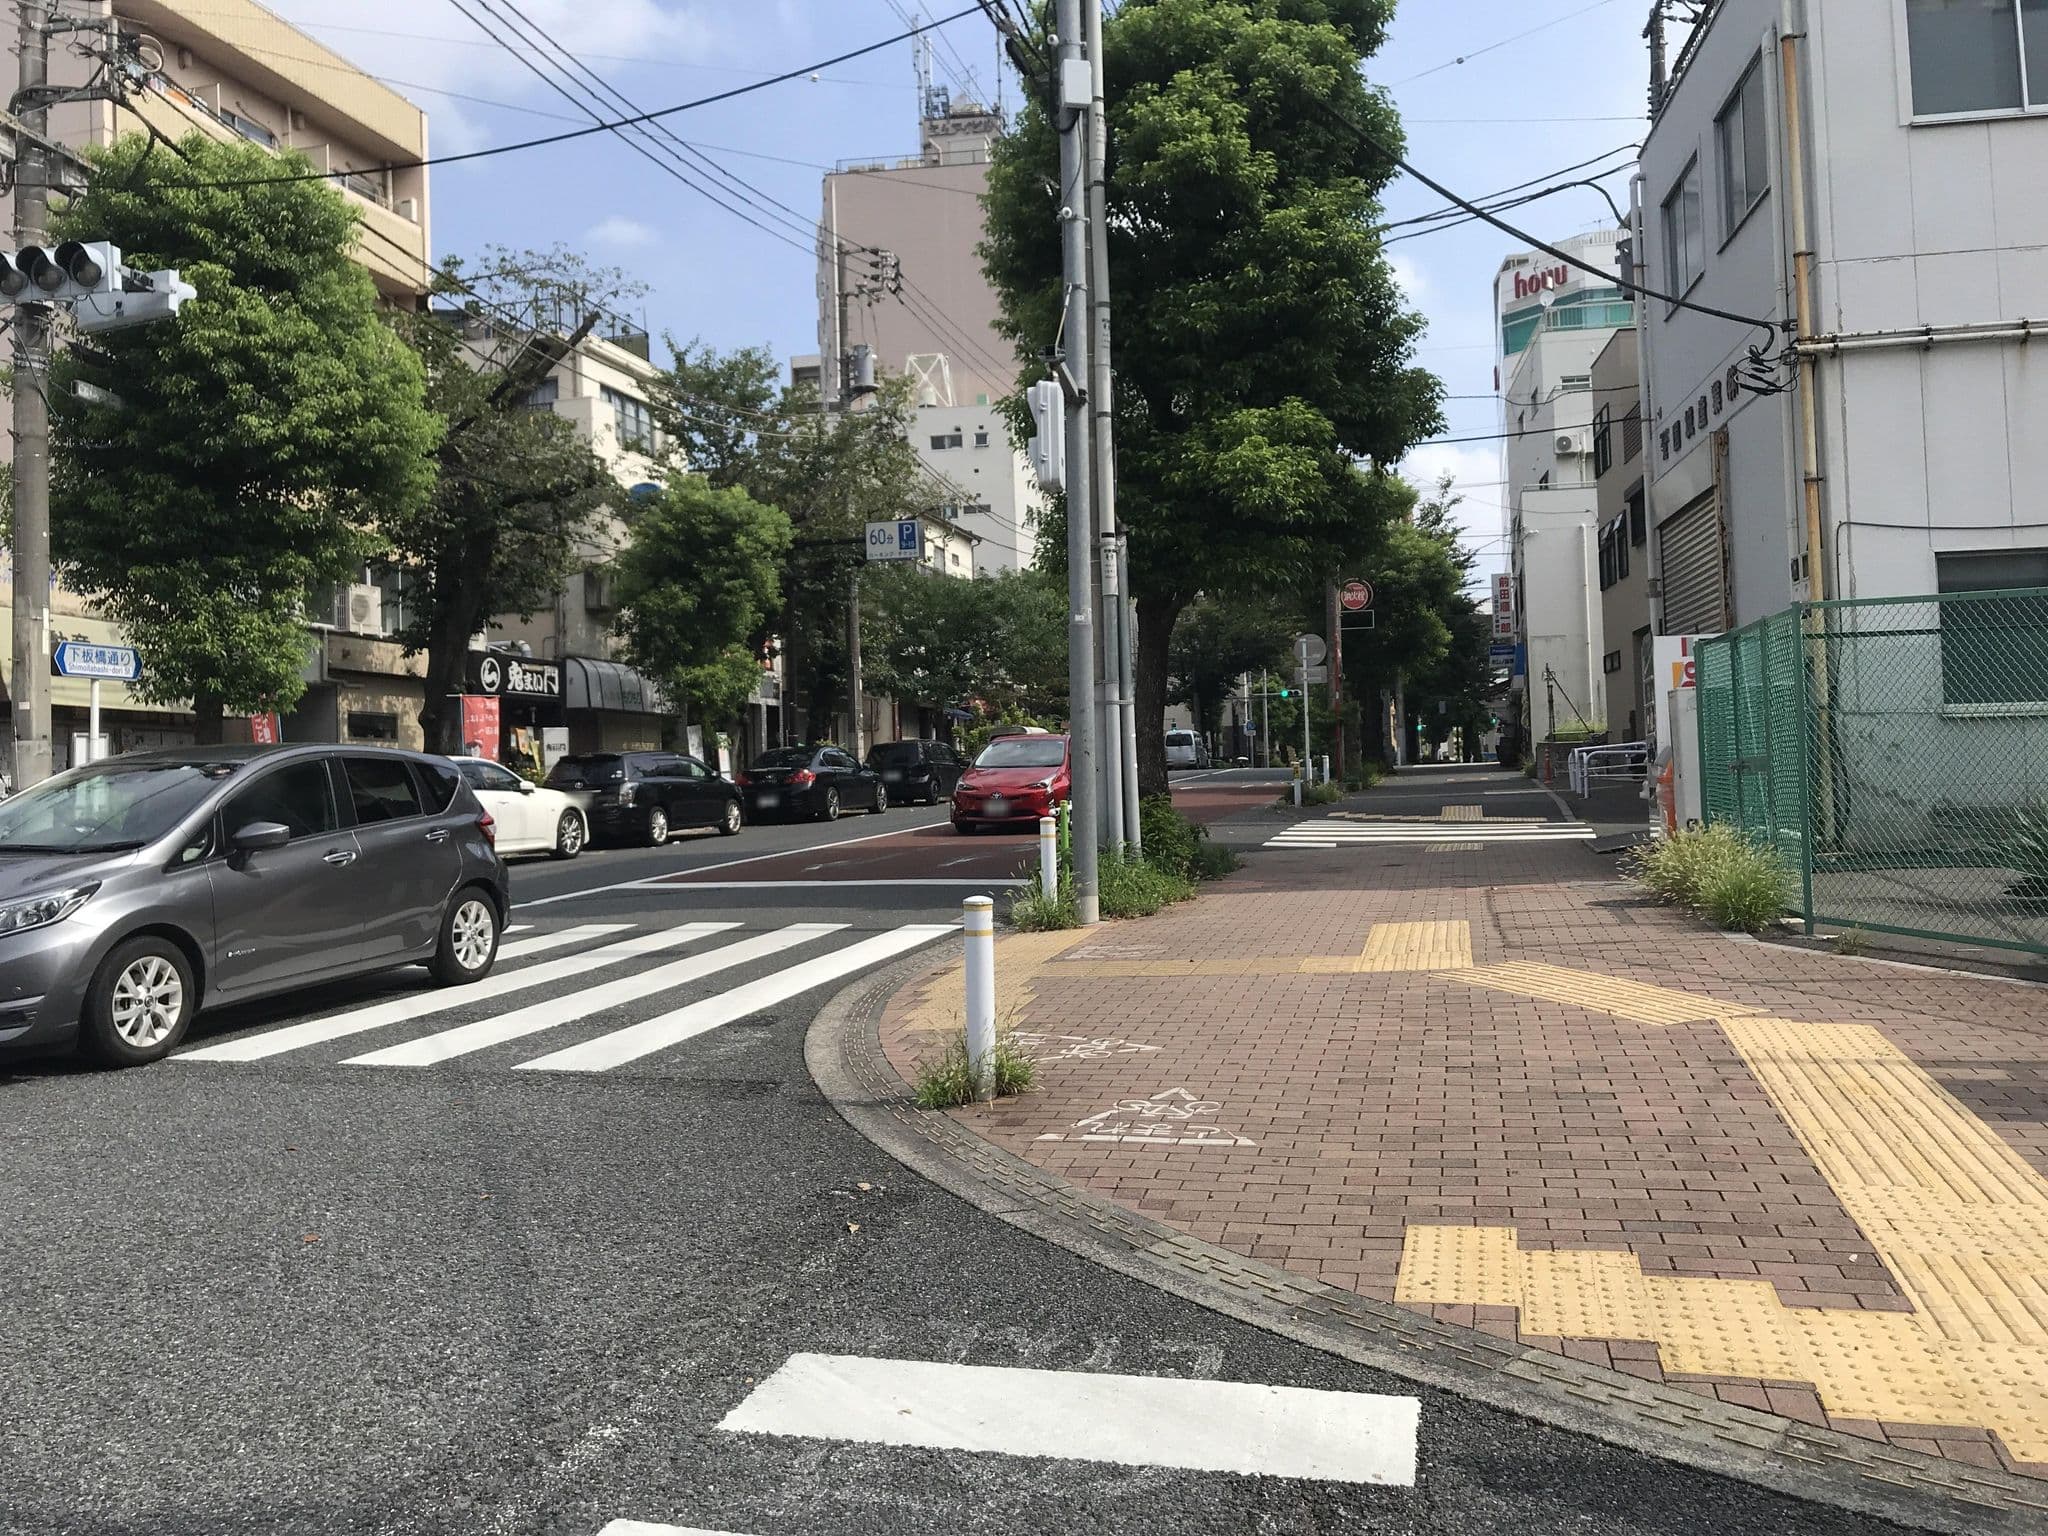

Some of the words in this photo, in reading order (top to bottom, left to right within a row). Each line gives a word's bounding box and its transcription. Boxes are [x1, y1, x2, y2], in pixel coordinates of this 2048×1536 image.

[903, 524, 913, 540] P
[1343, 590, 1366, 601] 消火栓
[69, 647, 131, 666] 下板橋通り
